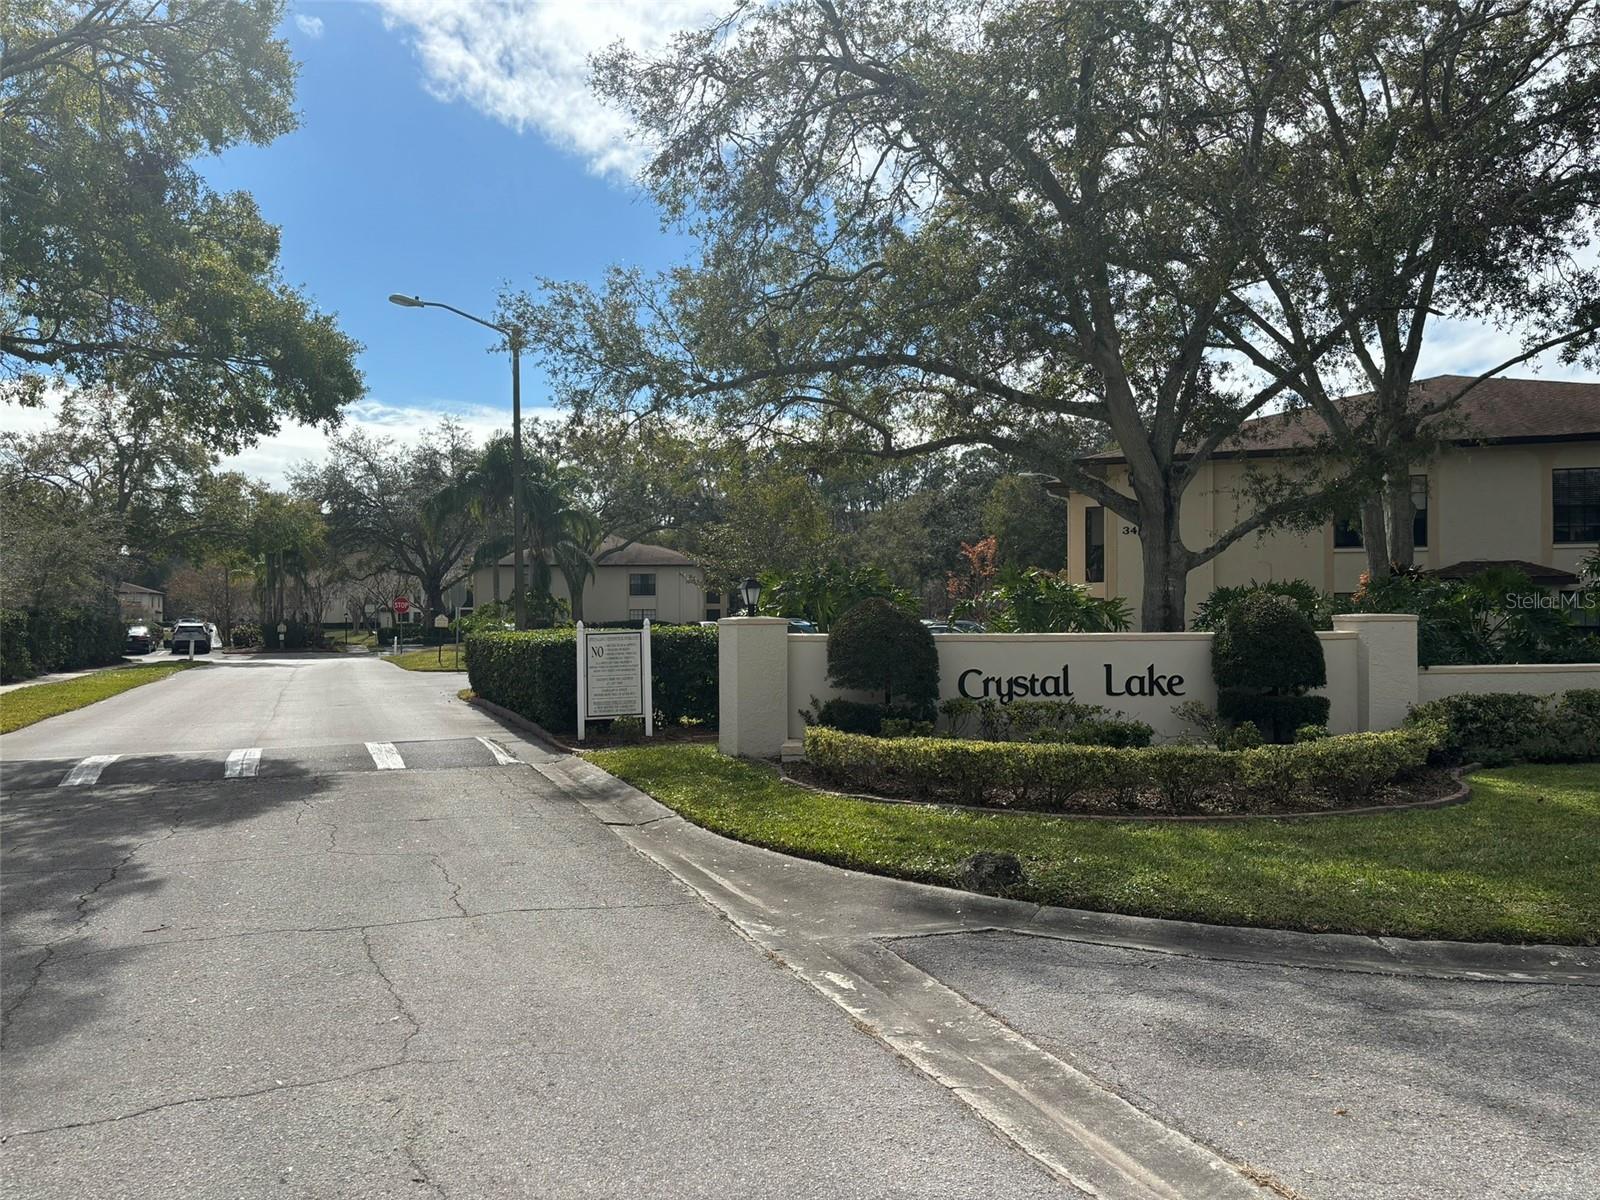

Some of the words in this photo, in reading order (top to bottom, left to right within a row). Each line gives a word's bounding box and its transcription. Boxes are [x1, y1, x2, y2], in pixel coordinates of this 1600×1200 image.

[394, 601, 409, 609] STOP
[591, 646, 604, 658] NO
[958, 664, 1074, 704] Crystal
[1103, 664, 1186, 697] Lake
